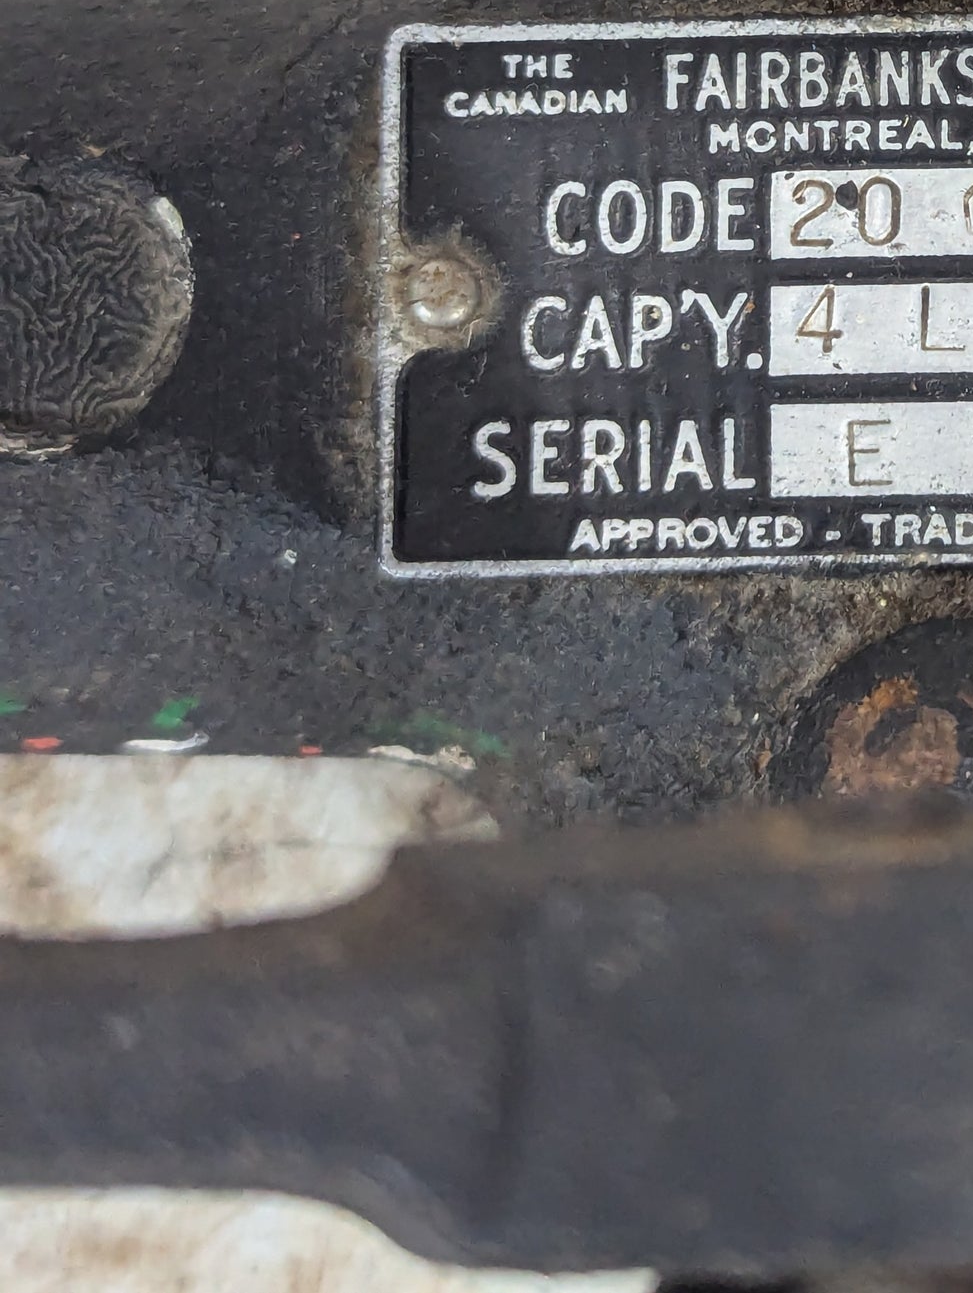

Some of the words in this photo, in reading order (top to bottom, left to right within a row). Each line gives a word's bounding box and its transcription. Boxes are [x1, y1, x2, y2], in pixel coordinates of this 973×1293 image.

[503, 53, 574, 80] THE
[444, 87, 629, 118] CANADIAN
[545, 176, 756, 256] CODE
[789, 175, 902, 248] 20
[795, 284, 844, 354] 4
[470, 416, 757, 498] SERIAL
[845, 417, 894, 488] E
[569, 512, 804, 553] APPROVED
